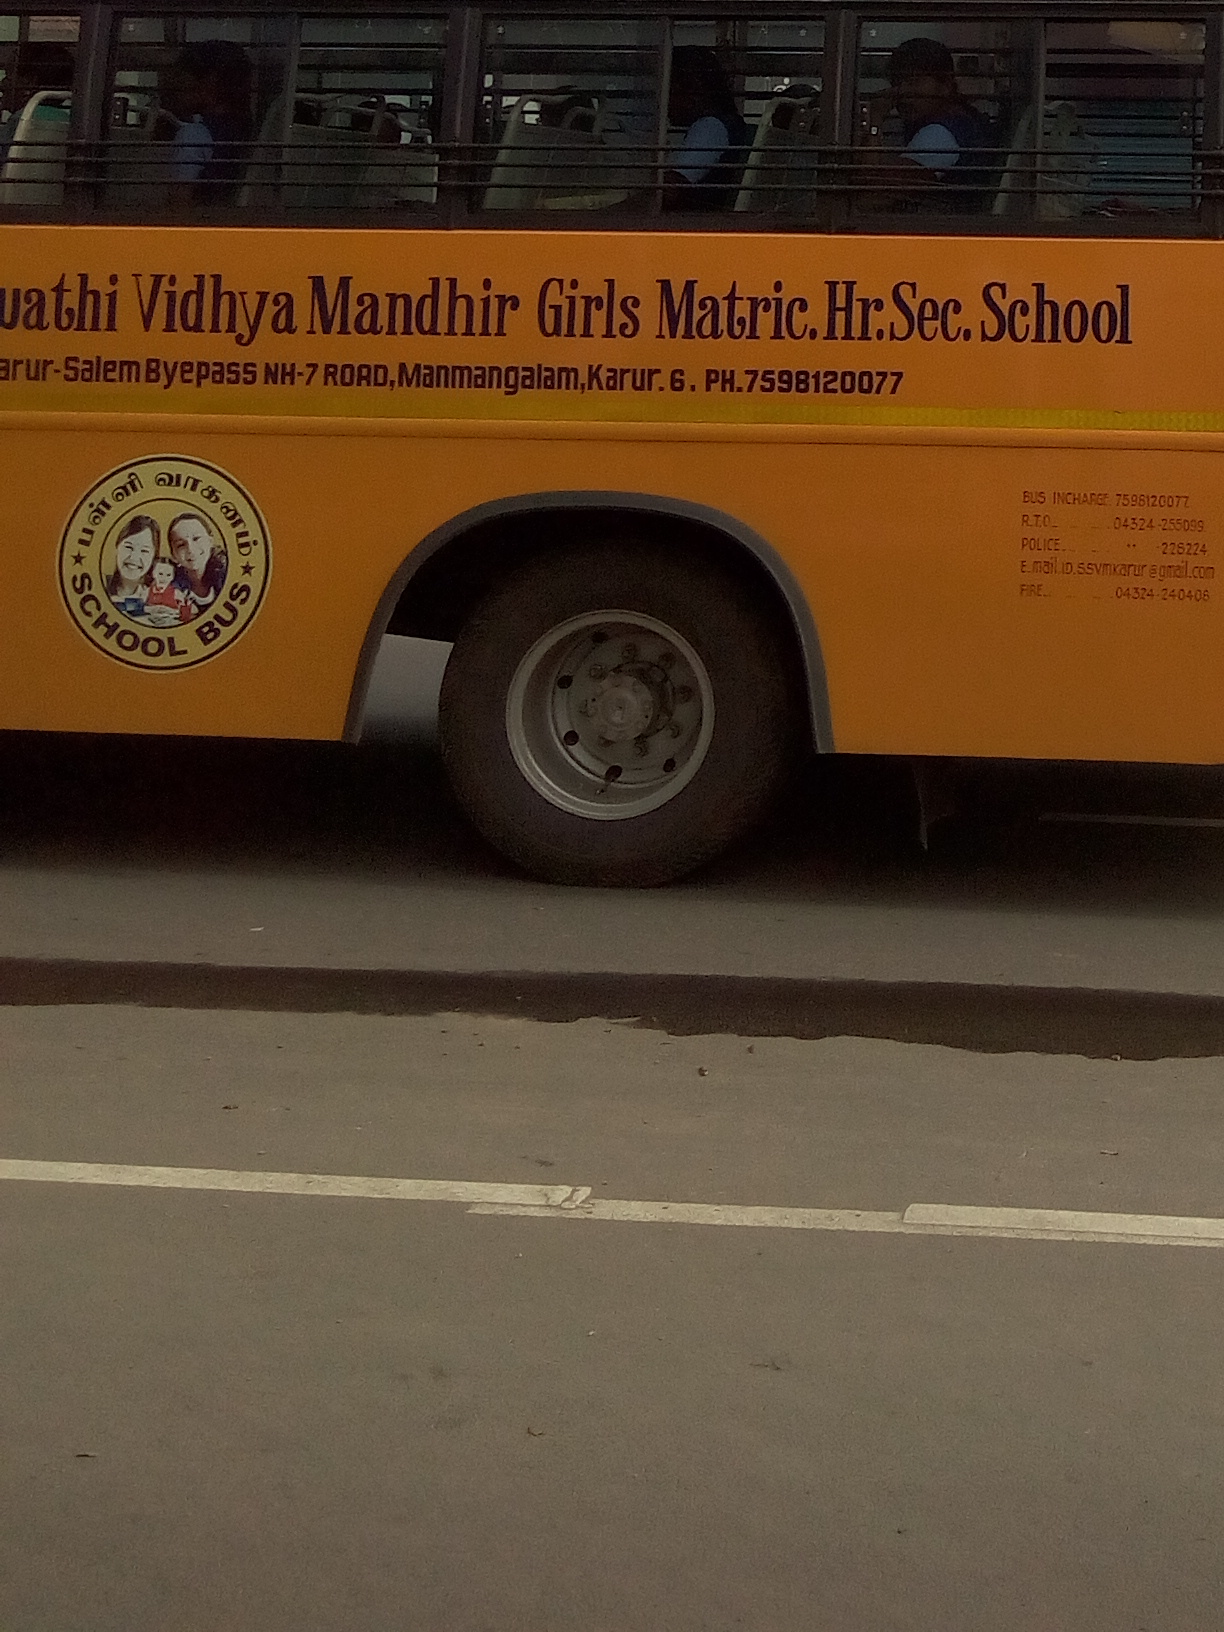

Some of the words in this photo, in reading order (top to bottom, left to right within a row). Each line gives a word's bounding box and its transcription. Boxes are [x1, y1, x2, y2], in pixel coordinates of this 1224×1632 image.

[131, 273, 298, 346] Vidhya
[306, 275, 520, 337] Mandhir
[537, 277, 640, 339] Girls
[980, 281, 1133, 345] School
[145, 357, 257, 389] Byepass
[263, 362, 319, 386] NH-7
[1022, 490, 1046, 504] BUS
[72, 572, 188, 658] SCHOOL
[195, 581, 252, 647] BUS
